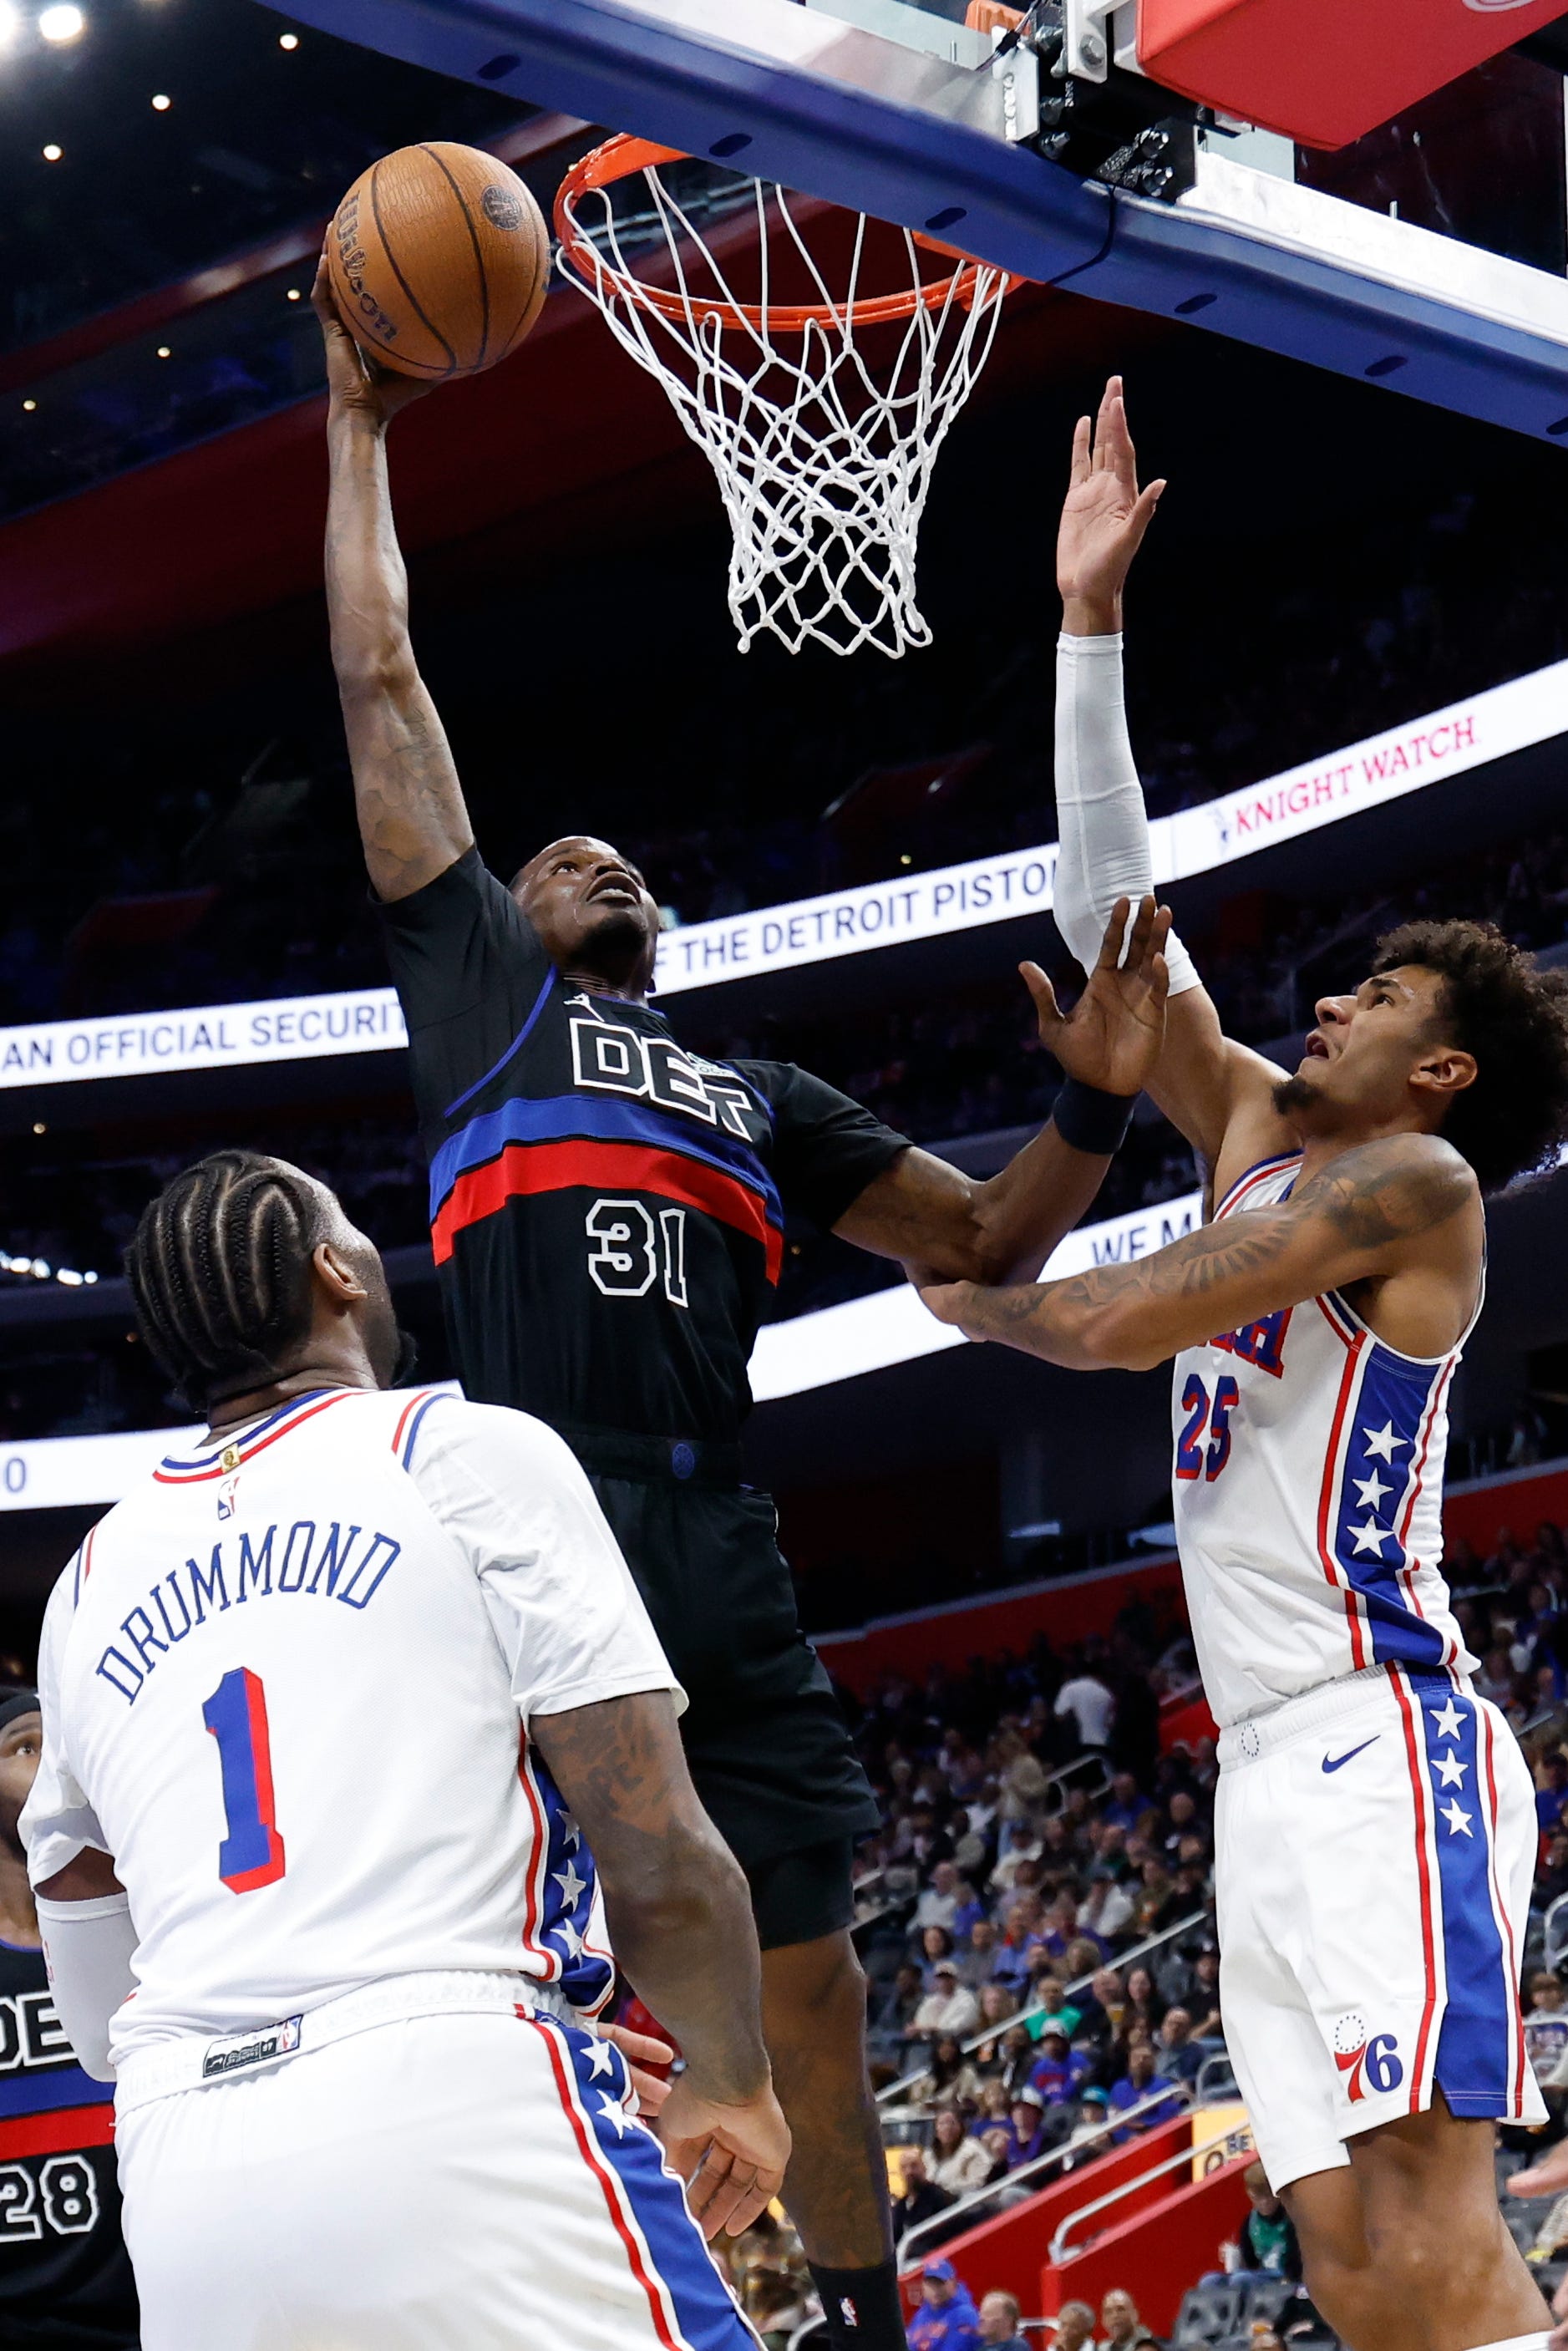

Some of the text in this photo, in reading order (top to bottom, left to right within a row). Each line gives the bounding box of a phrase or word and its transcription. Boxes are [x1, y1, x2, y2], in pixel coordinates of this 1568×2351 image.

[336, 190, 399, 343] Wilson
[1236, 715, 1474, 835] KNIGHT WATCH
[3, 1039, 52, 1070] AN
[69, 1019, 236, 1064] OFFICIAL
[680, 929, 749, 972] THE
[763, 891, 921, 955] DETROIT
[934, 860, 1056, 917] PISTO
[570, 1018, 752, 1141] DET
[586, 1199, 688, 1308] 31
[1175, 1374, 1239, 1482] 25
[95, 1521, 401, 1705] DRUMMOND
[201, 1666, 286, 1895] 1
[1334, 2034, 1403, 2105] 76
[0, 2155, 99, 2243] 28
